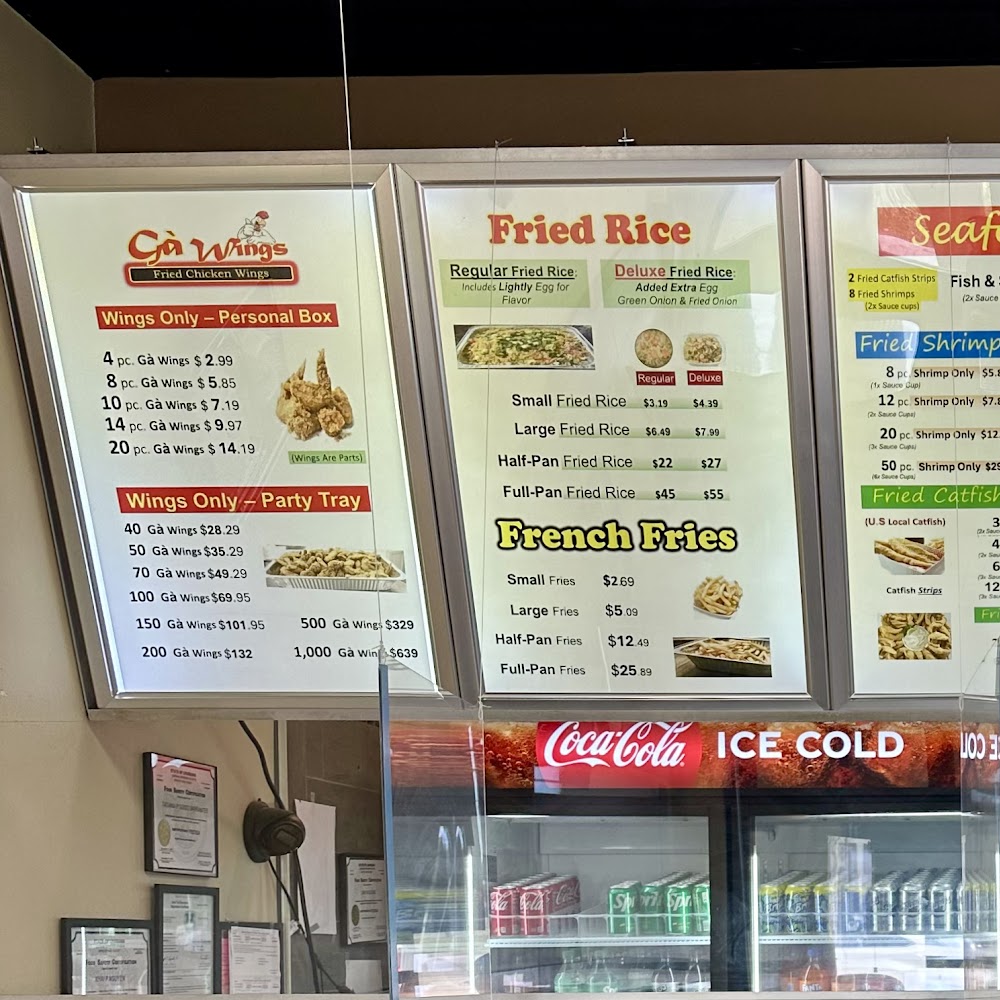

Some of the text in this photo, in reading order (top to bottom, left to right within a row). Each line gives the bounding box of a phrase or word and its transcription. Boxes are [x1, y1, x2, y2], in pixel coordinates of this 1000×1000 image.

[488, 214, 691, 244] Fried Rice
[128, 229, 289, 266] Gà Wings
[153, 268, 270, 280] Fried Chicken Wings
[450, 264, 578, 279] Regular Fried Rice:
[615, 264, 737, 278] Deluxe Fried Rice:
[848, 273, 936, 285] 2 Fried Catfish Strips
[950, 274, 980, 288] Fish
[984, 275, 995, 287] &
[461, 281, 570, 294] Includes Lightly Egg for
[635, 283, 718, 294] Added Extra Egg
[502, 295, 532, 305] Flavor
[102, 310, 155, 328] Wings
[159, 310, 199, 327] Only
[219, 309, 294, 325] Personal
[299, 309, 332, 324] Box
[860, 335, 914, 352] Fried
[103, 351, 233, 369] 4 pc. Gà Wings $ 2.99
[637, 373, 722, 384] Regular Deluxe
[512, 394, 719, 408] Small Fried Rice $3.19 $4.39
[110, 441, 255, 457] 20 pc. Gà Wings $ 14.19
[291, 452, 363, 463] (Wings Are Parts)
[881, 461, 897, 472] 50
[899, 463, 914, 473] pc.
[918, 462, 955, 473] Shrimp
[957, 462, 981, 473] Only
[126, 493, 188, 510] Wings
[193, 493, 238, 510] Only
[262, 492, 312, 512] Party
[318, 492, 361, 510] Tray
[873, 488, 924, 503] Fried
[124, 523, 240, 536] 40 Gà Wings $28.29
[496, 519, 738, 551] French Fries
[886, 586, 942, 596] Catfish Strips
[985, 582, 1000, 592] 12
[129, 591, 251, 604] 100 Gà Wings $69.95
[500, 663, 652, 677] Full-Pan Fries $25.89
[543, 721, 905, 768] Coca-Cola ICE COLD
